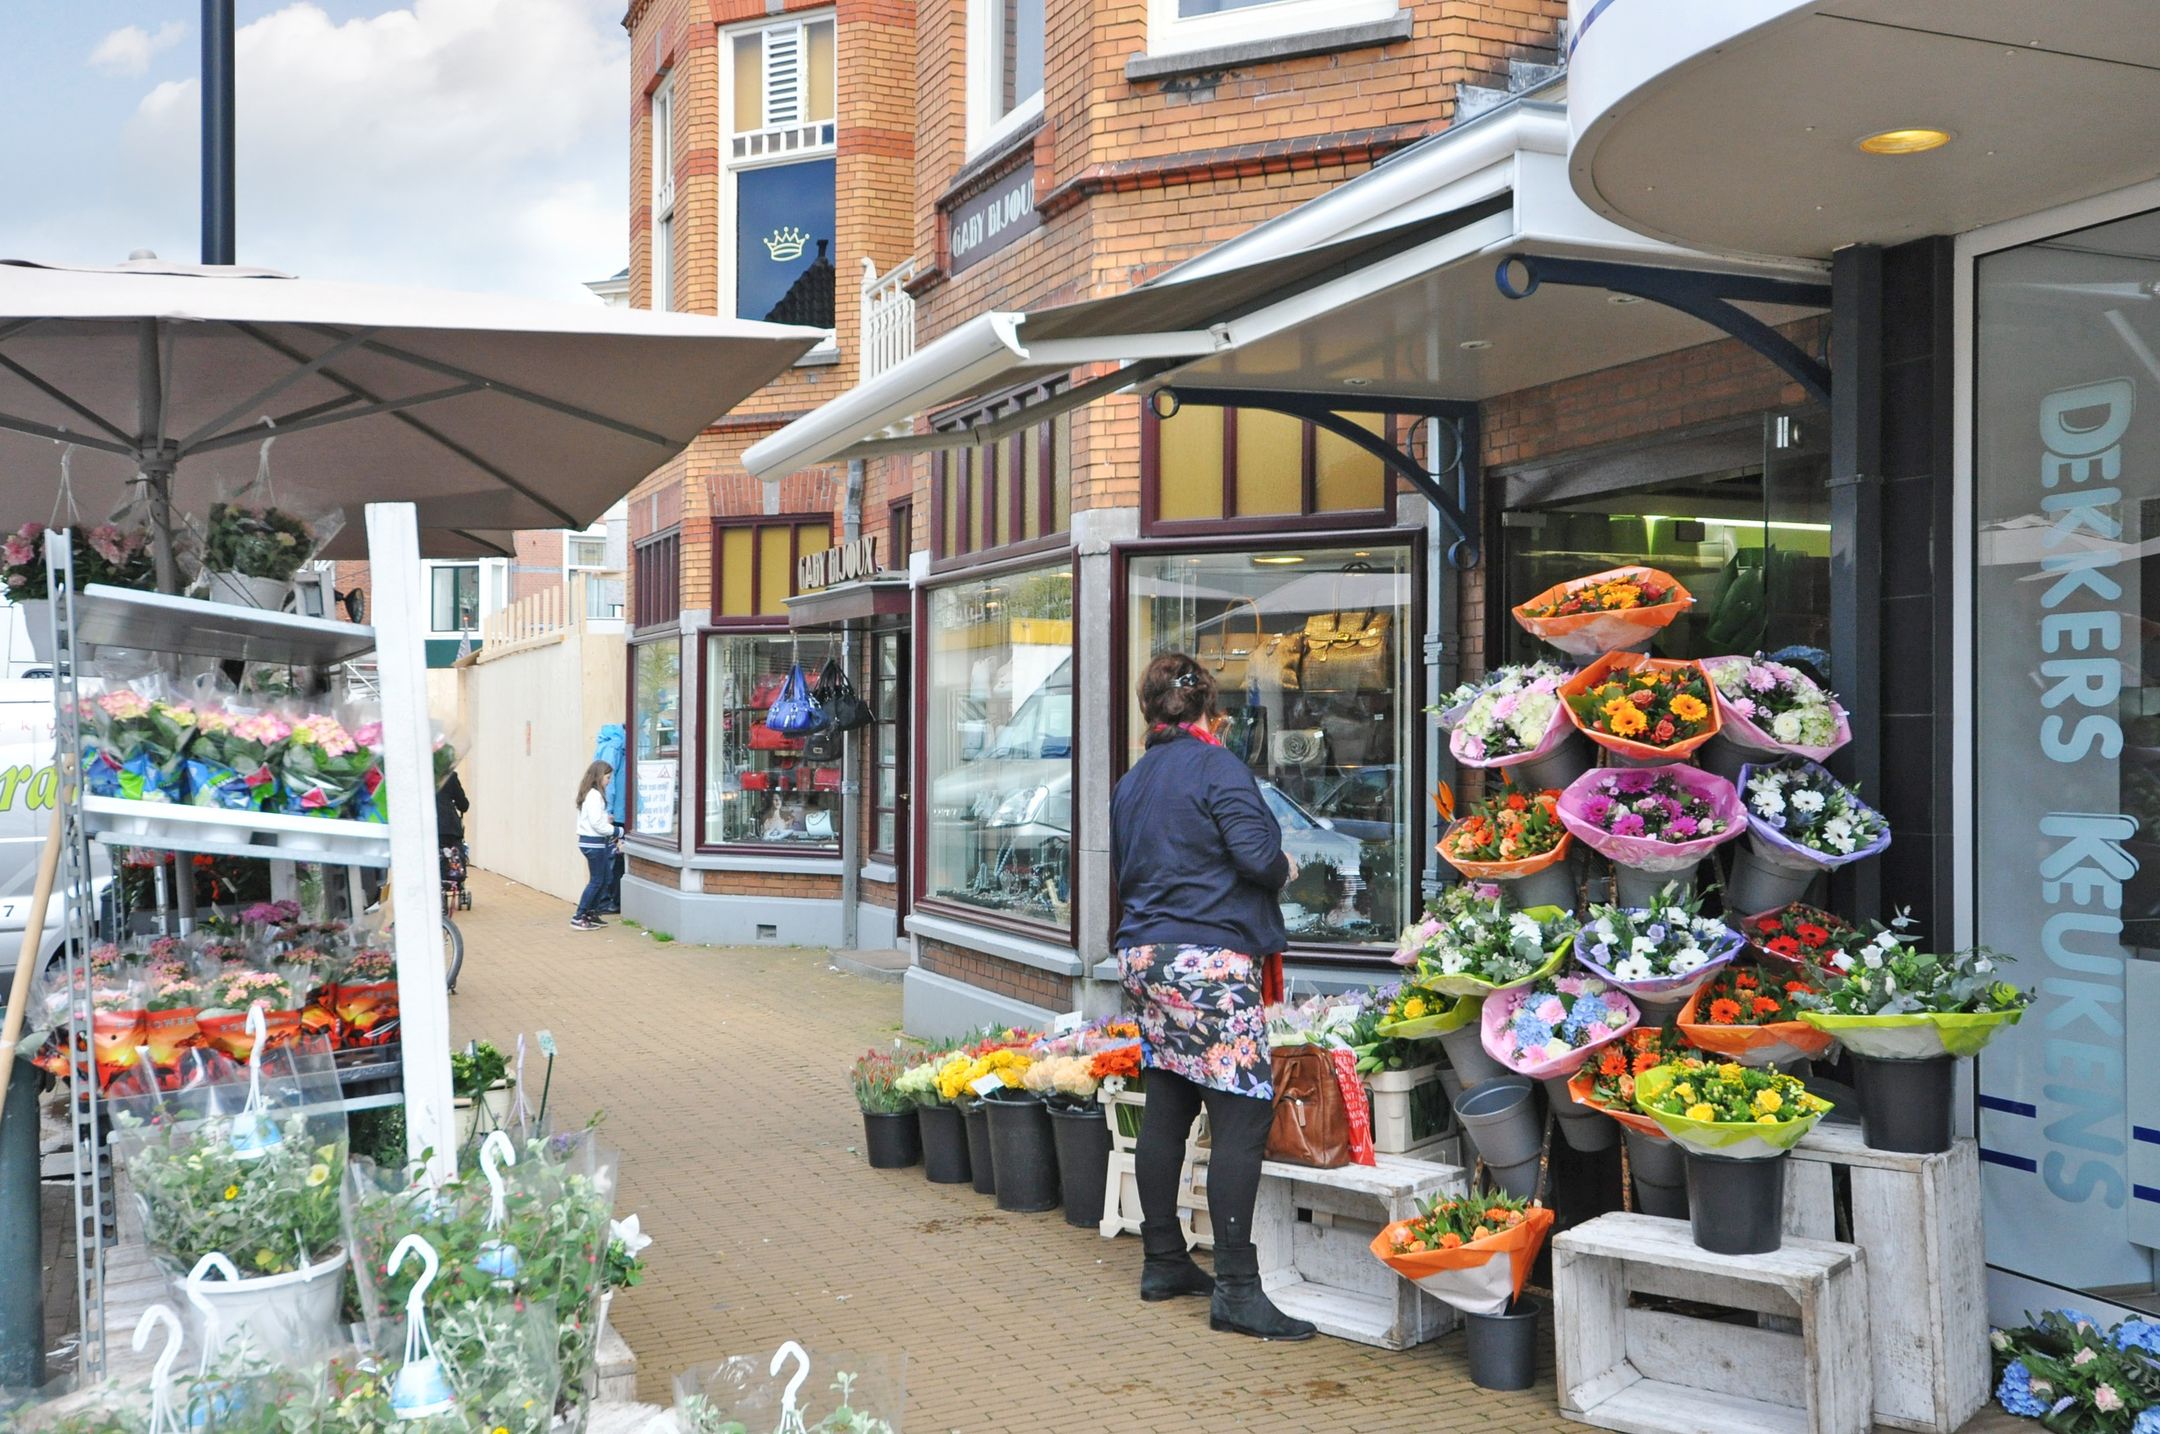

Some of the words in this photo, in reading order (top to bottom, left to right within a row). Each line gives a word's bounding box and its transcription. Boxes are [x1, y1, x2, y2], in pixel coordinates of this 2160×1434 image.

[952, 209, 985, 257] GABY
[987, 178, 1035, 239] BIJOU
[798, 550, 826, 590] GABY
[828, 536, 874, 585] BIJOUX
[2039, 375, 2137, 763] DEKKERS
[2039, 810, 2140, 1211] KEUKENS
